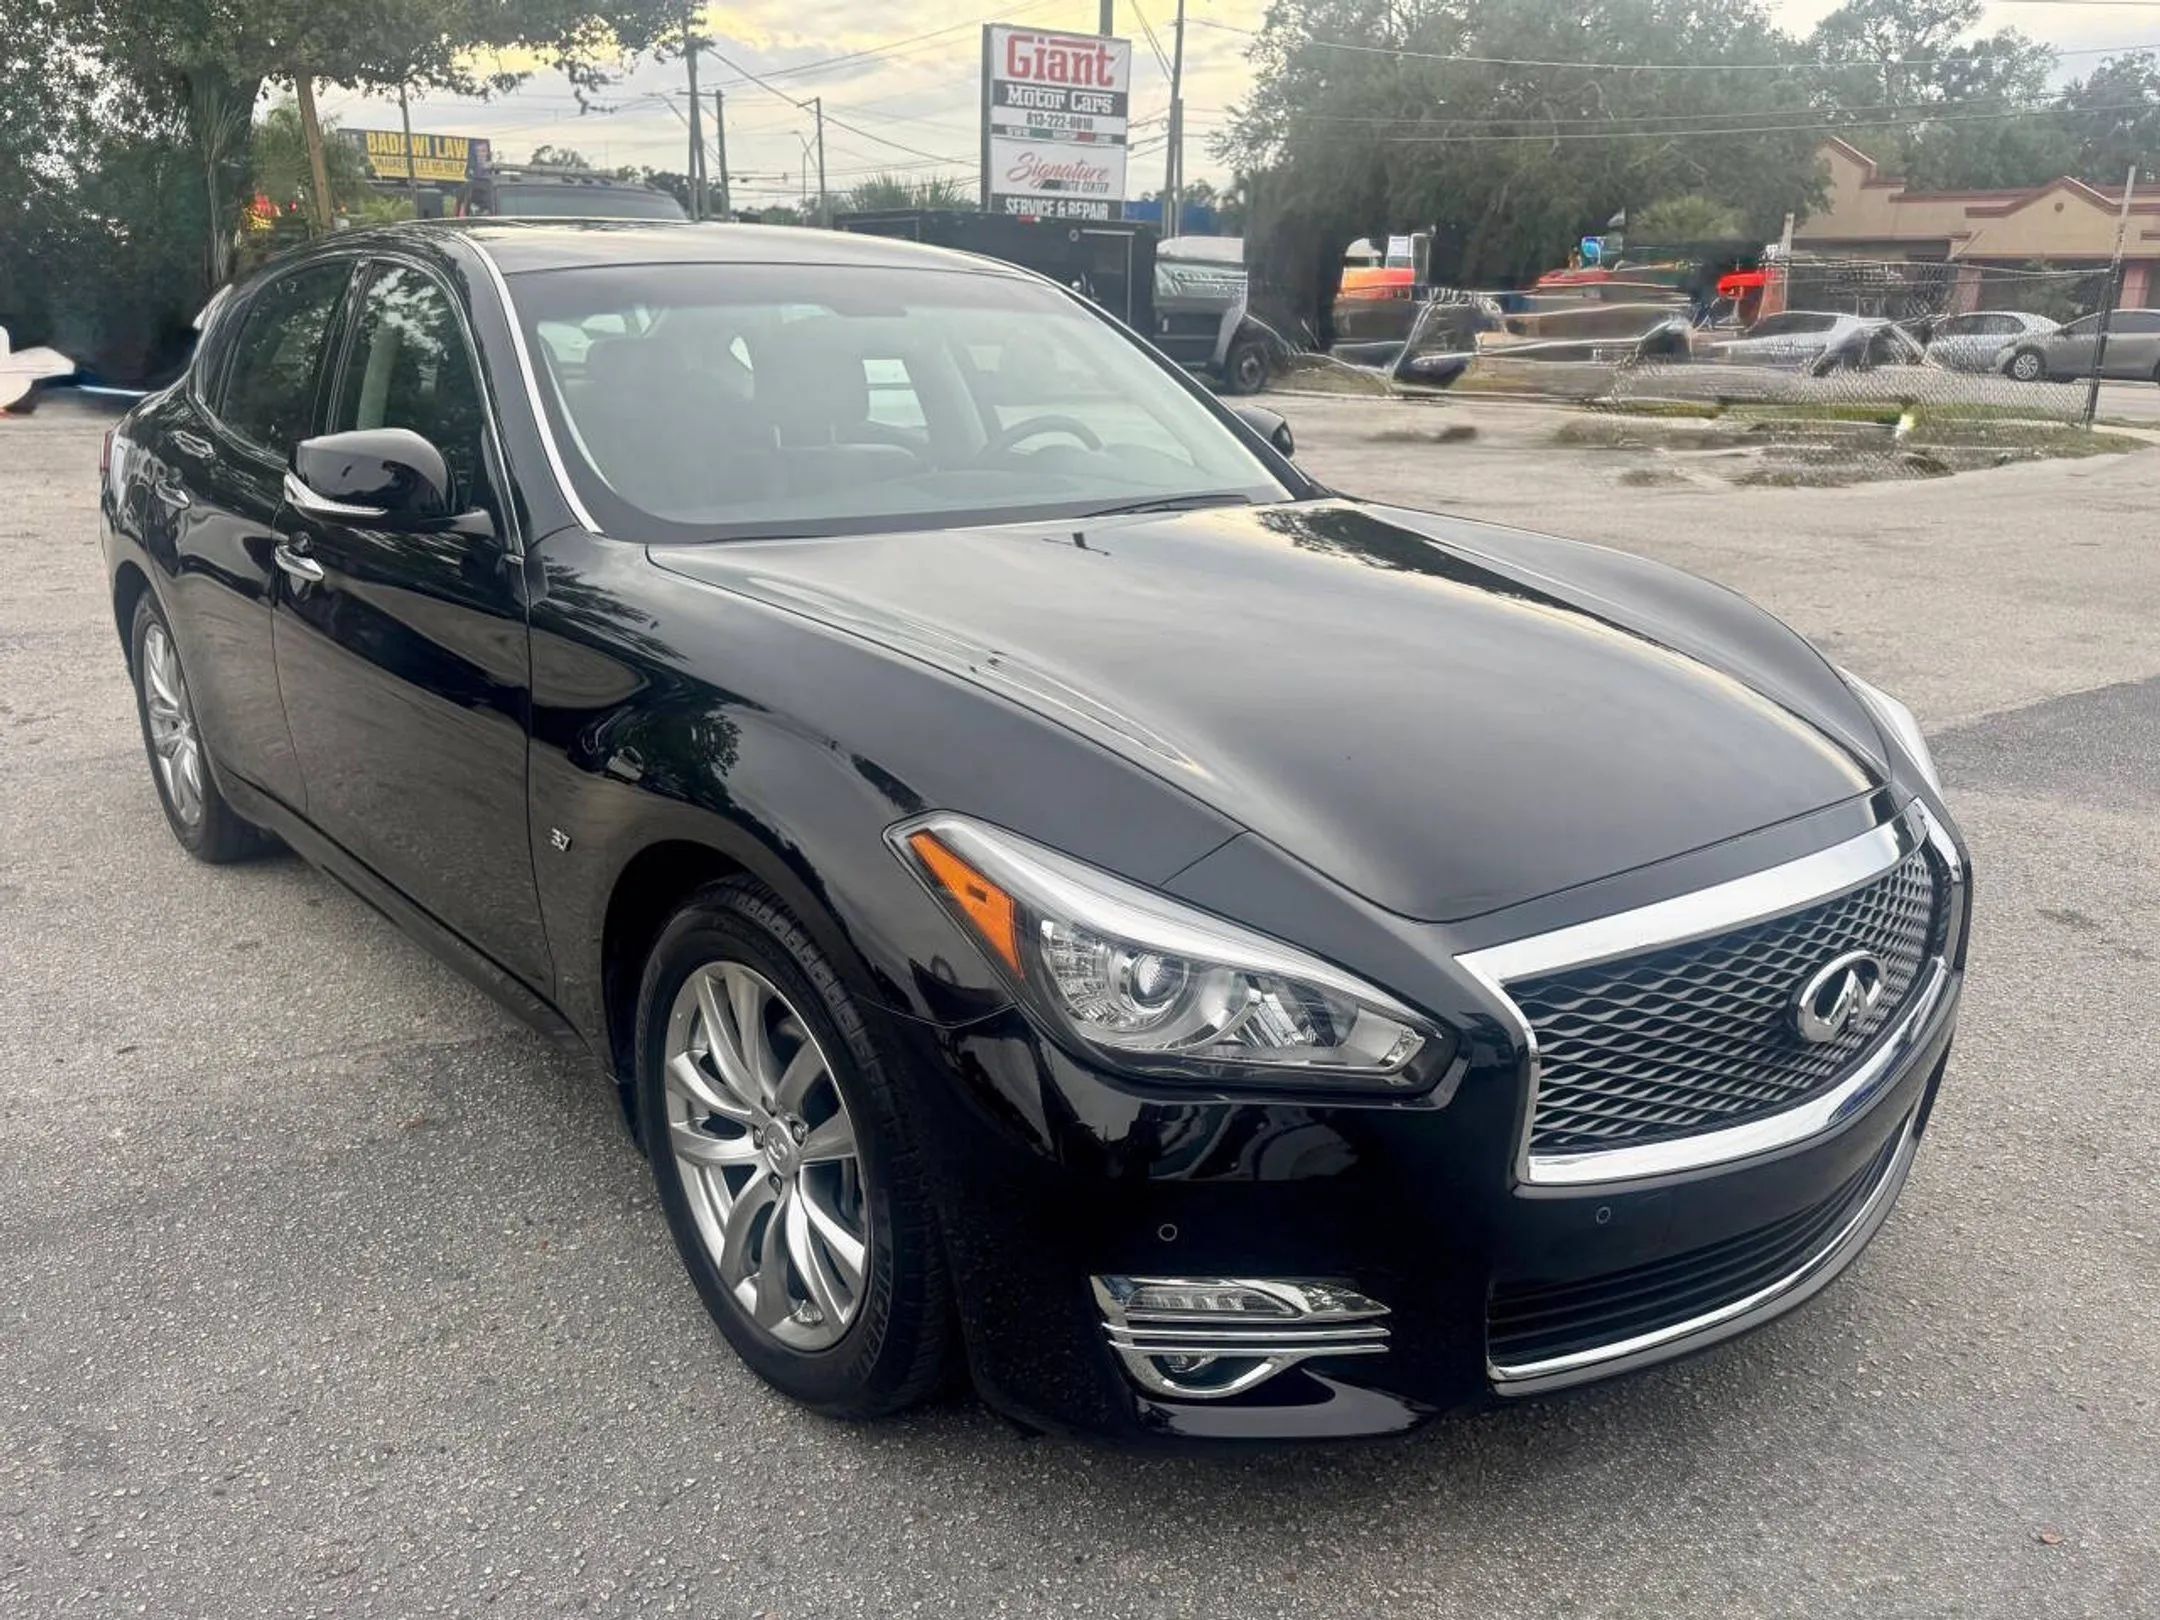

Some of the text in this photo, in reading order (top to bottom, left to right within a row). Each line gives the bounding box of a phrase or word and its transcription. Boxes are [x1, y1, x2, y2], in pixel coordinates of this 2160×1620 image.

[1007, 33, 1115, 86] Giant
[1005, 84, 1114, 114] Motor Cars
[435, 137, 468, 159] LAW
[1006, 152, 1109, 189] Signature
[1005, 197, 1109, 220] SERVICE & REPAIR
